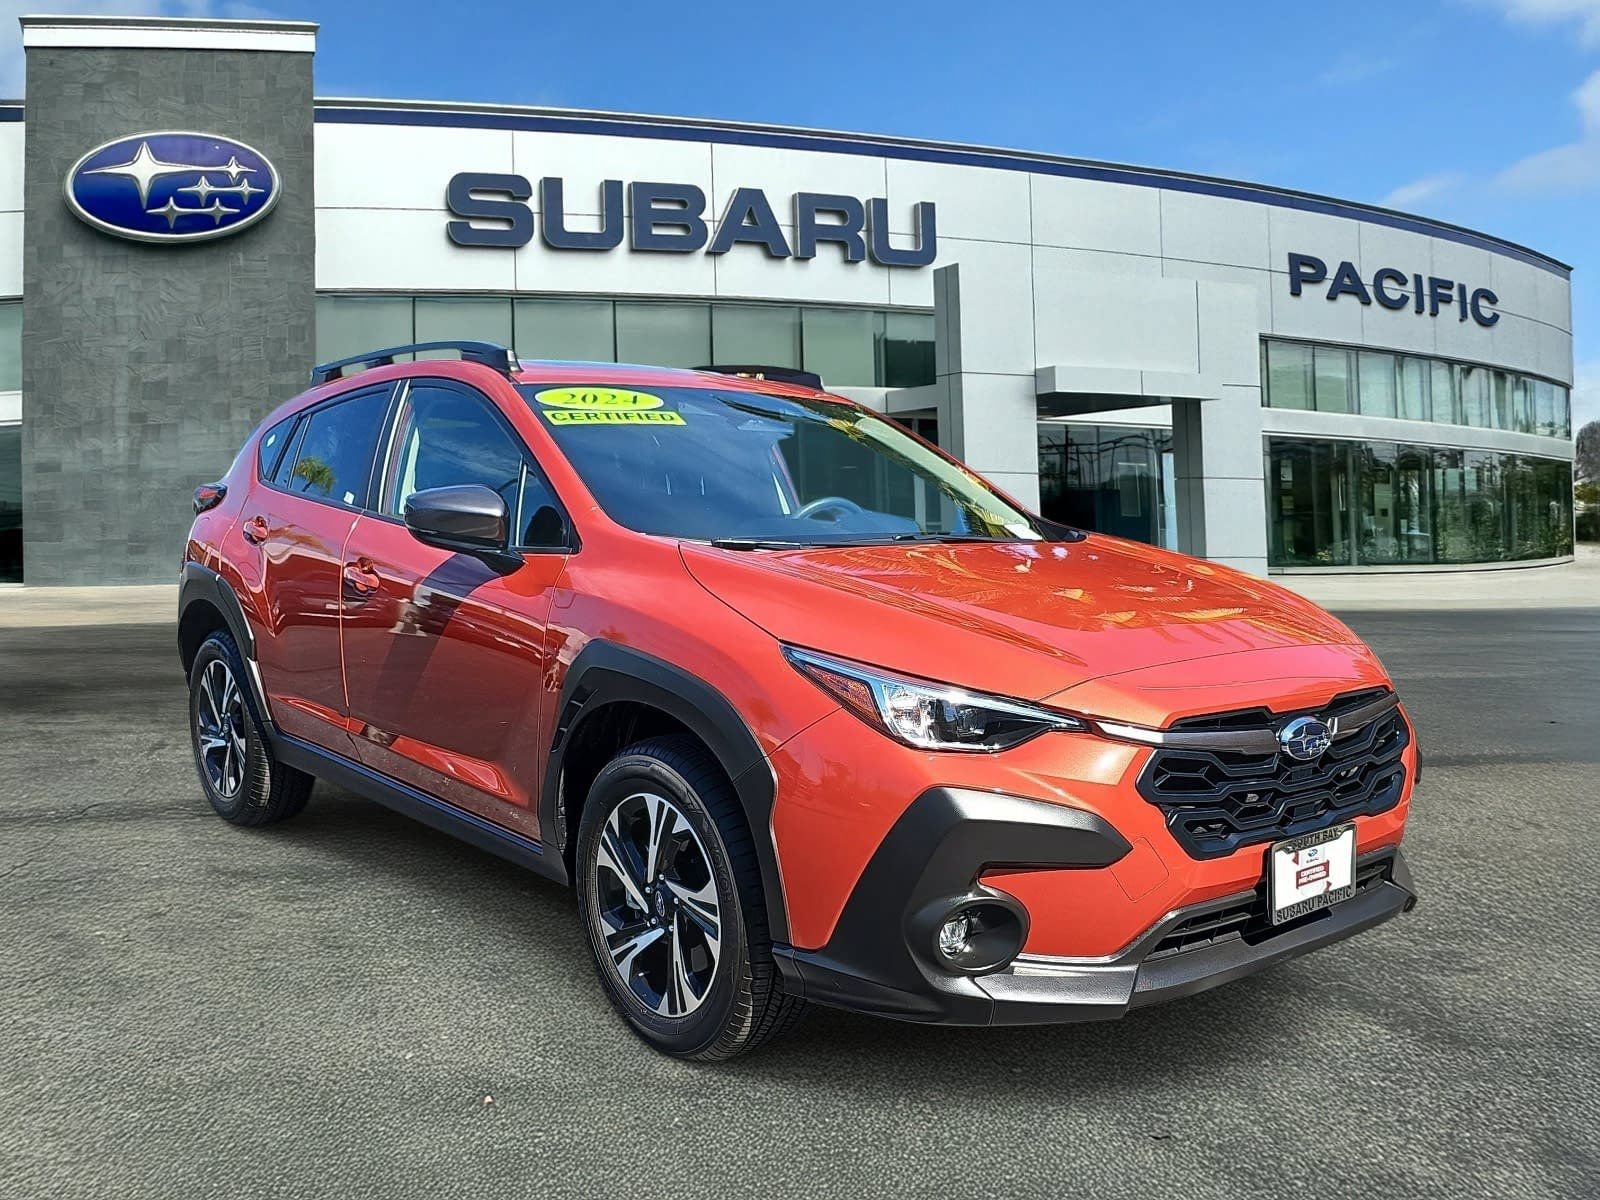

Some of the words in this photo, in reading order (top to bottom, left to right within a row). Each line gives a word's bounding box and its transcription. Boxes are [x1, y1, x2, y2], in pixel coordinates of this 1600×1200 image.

[447, 172, 937, 268] SUBARU
[1287, 252, 1500, 327] PACIFIC
[551, 412, 674, 421] CERTIFIED
[563, 393, 638, 405] 2024
[1276, 897, 1315, 923] SUBARU
[1317, 886, 1352, 908] PACIFIC
